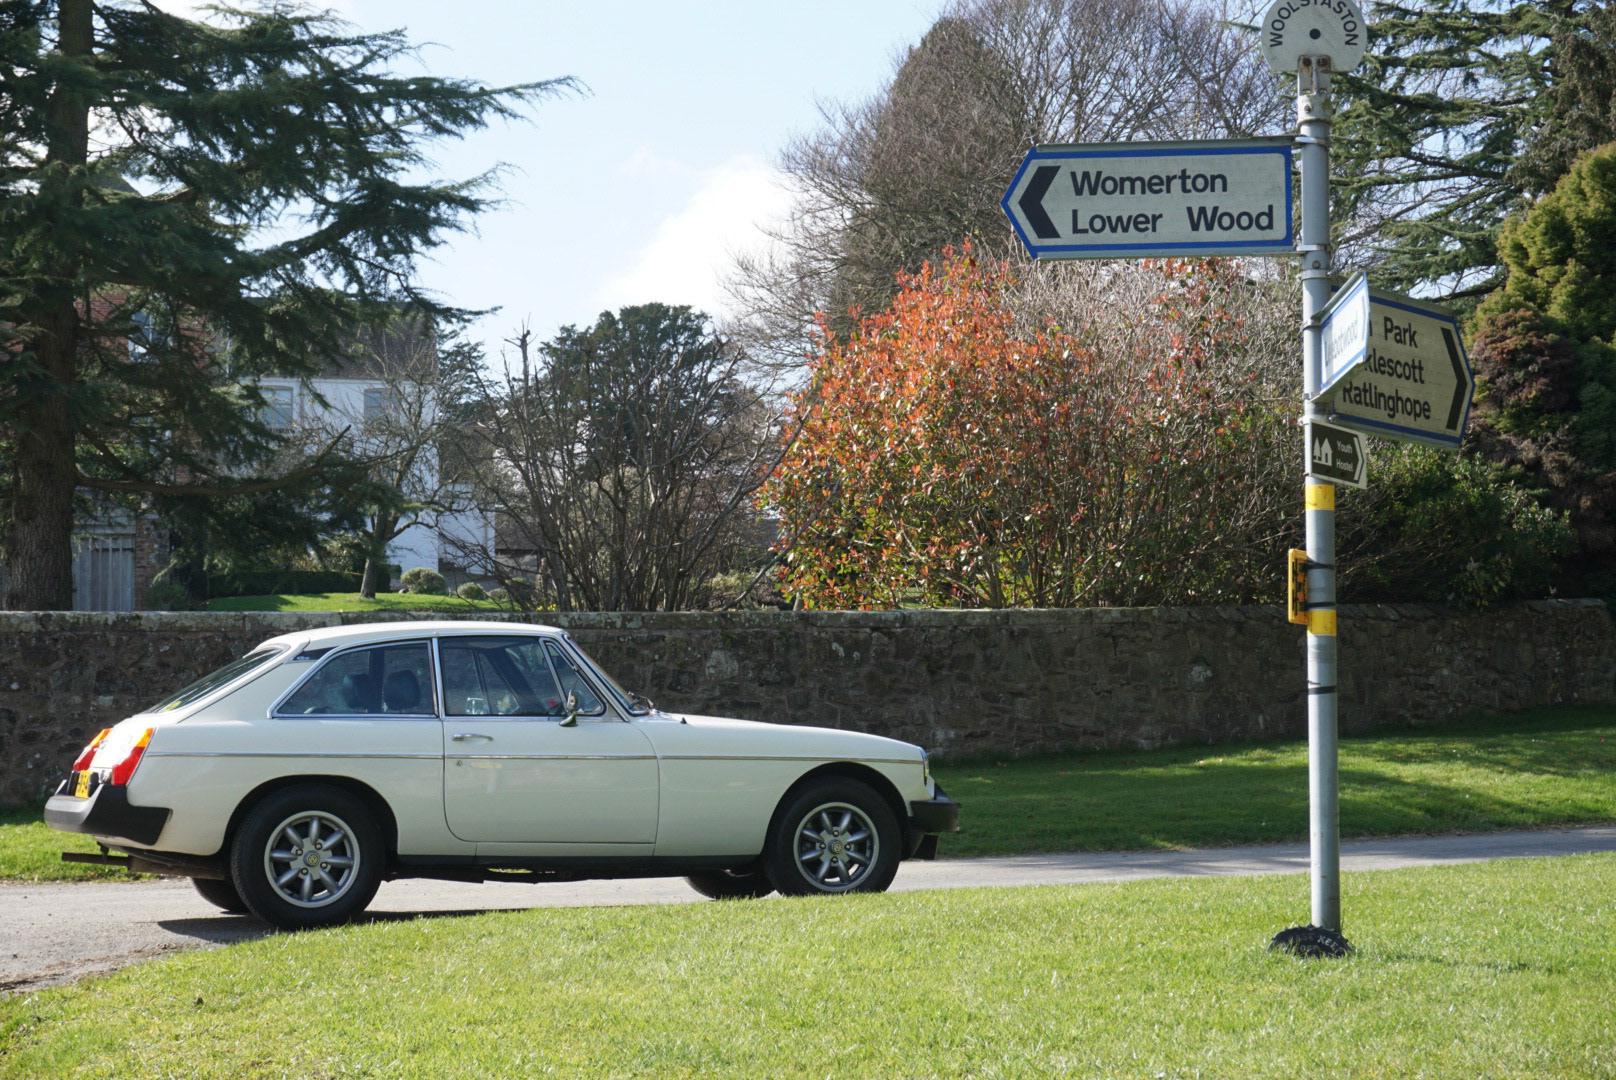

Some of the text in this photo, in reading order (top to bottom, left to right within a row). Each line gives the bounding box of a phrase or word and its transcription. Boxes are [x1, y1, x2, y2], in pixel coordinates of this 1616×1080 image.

[1070, 168, 1228, 196] Womerton
[1072, 204, 1274, 234] Lower Wood
[1383, 316, 1418, 348] Park
[1364, 348, 1425, 384] klescott
[1342, 381, 1431, 421] Ratlinghope
[1336, 440, 1353, 454] Youth
[1336, 458, 1354, 472] Hostel
